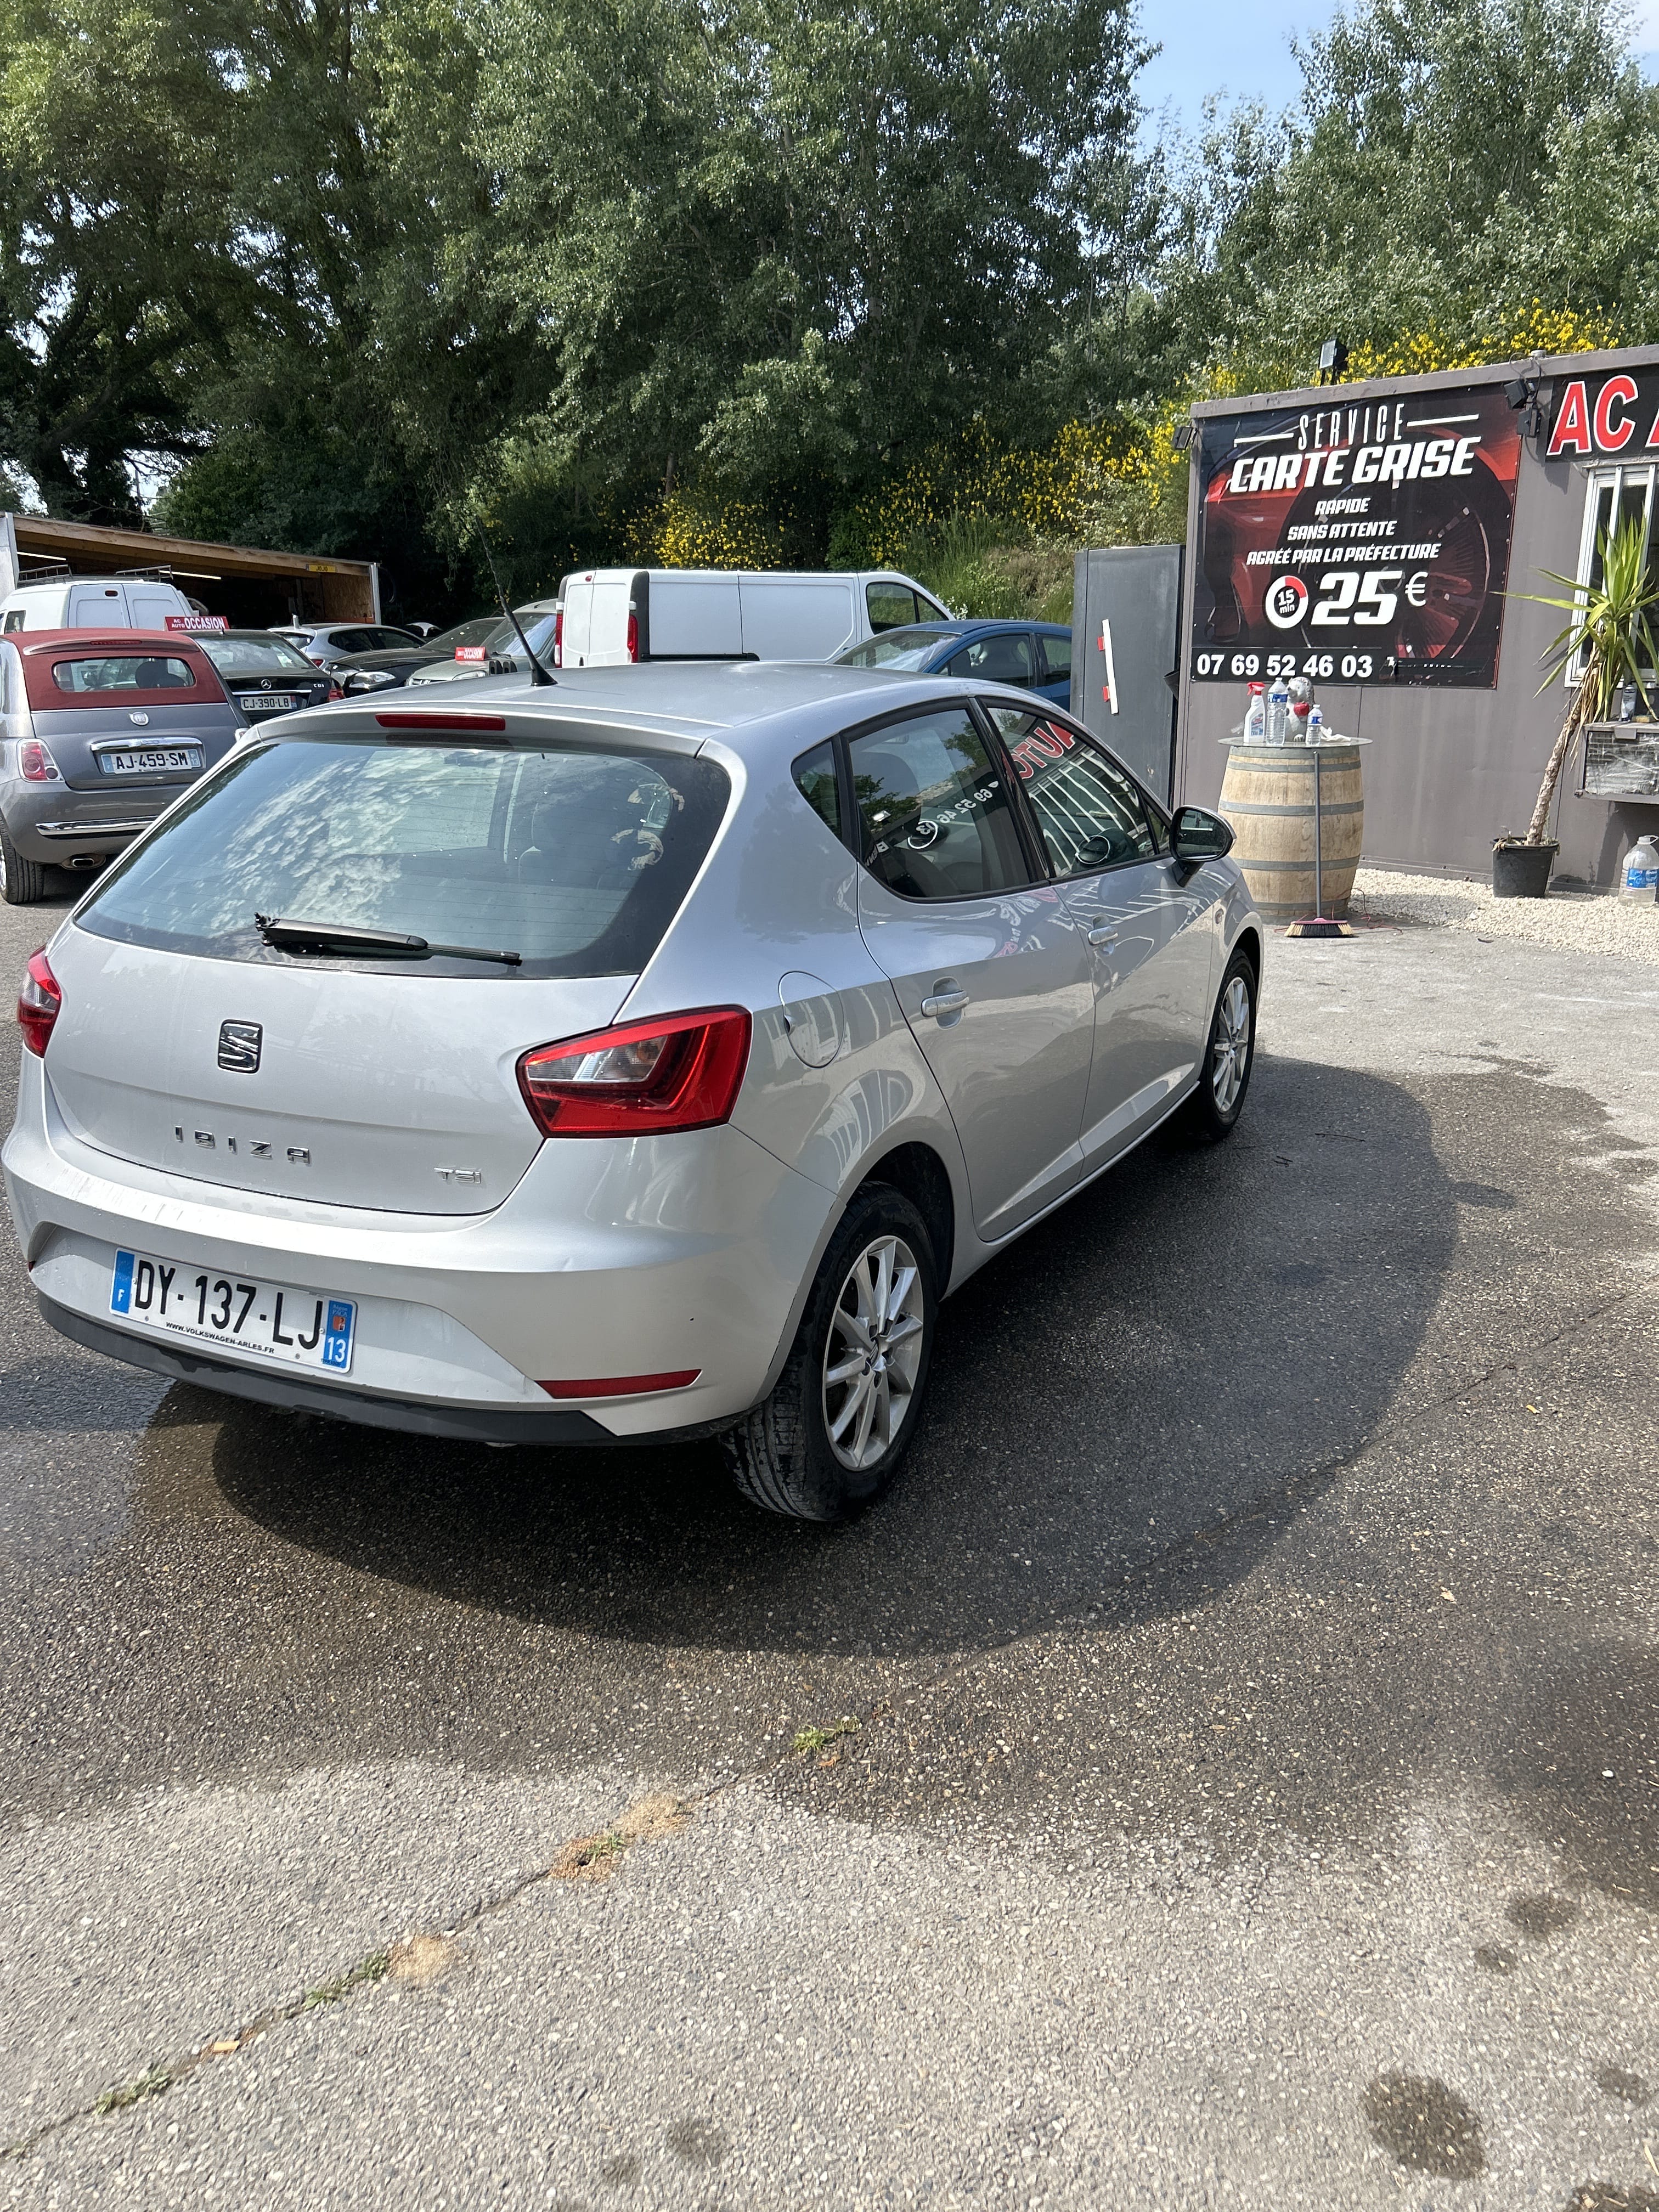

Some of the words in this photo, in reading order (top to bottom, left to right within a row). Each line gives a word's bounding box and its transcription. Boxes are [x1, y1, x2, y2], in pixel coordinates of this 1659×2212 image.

[1298, 403, 1404, 450] SERVICE
[1547, 375, 1639, 455] AC
[1229, 449, 1350, 493] CARTE
[1352, 436, 1481, 484] GRISE
[1315, 498, 1371, 515] RAPIDE
[1288, 522, 1329, 540] SANS
[1329, 521, 1397, 538] ATTENTE
[1246, 548, 1291, 565] AGRÉÉ
[1292, 549, 1323, 563] PAR
[1323, 548, 1342, 563] LA
[1344, 543, 1441, 562] PRÉFECTURE
[1278, 590, 1295, 603] 15
[1279, 602, 1295, 614] min
[1311, 571, 1403, 625] 25
[184, 617, 225, 629] OCCASION
[1197, 654, 1224, 674] 07
[1231, 655, 1259, 675] 69
[1266, 655, 1295, 676] 52
[1302, 656, 1333, 676] 46
[1341, 656, 1373, 678] 03
[243, 698, 289, 708] CJ-390-LB
[116, 752, 188, 770] AJ-459-SM
[175, 1125, 310, 1164] IBIZA
[117, 1289, 125, 1302] F
[135, 1260, 323, 1350] DY-137-LJ
[166, 1322, 275, 1354] WWW.VOLKSWAGEN-ARLES.FR
[328, 1336, 346, 1363] 13
